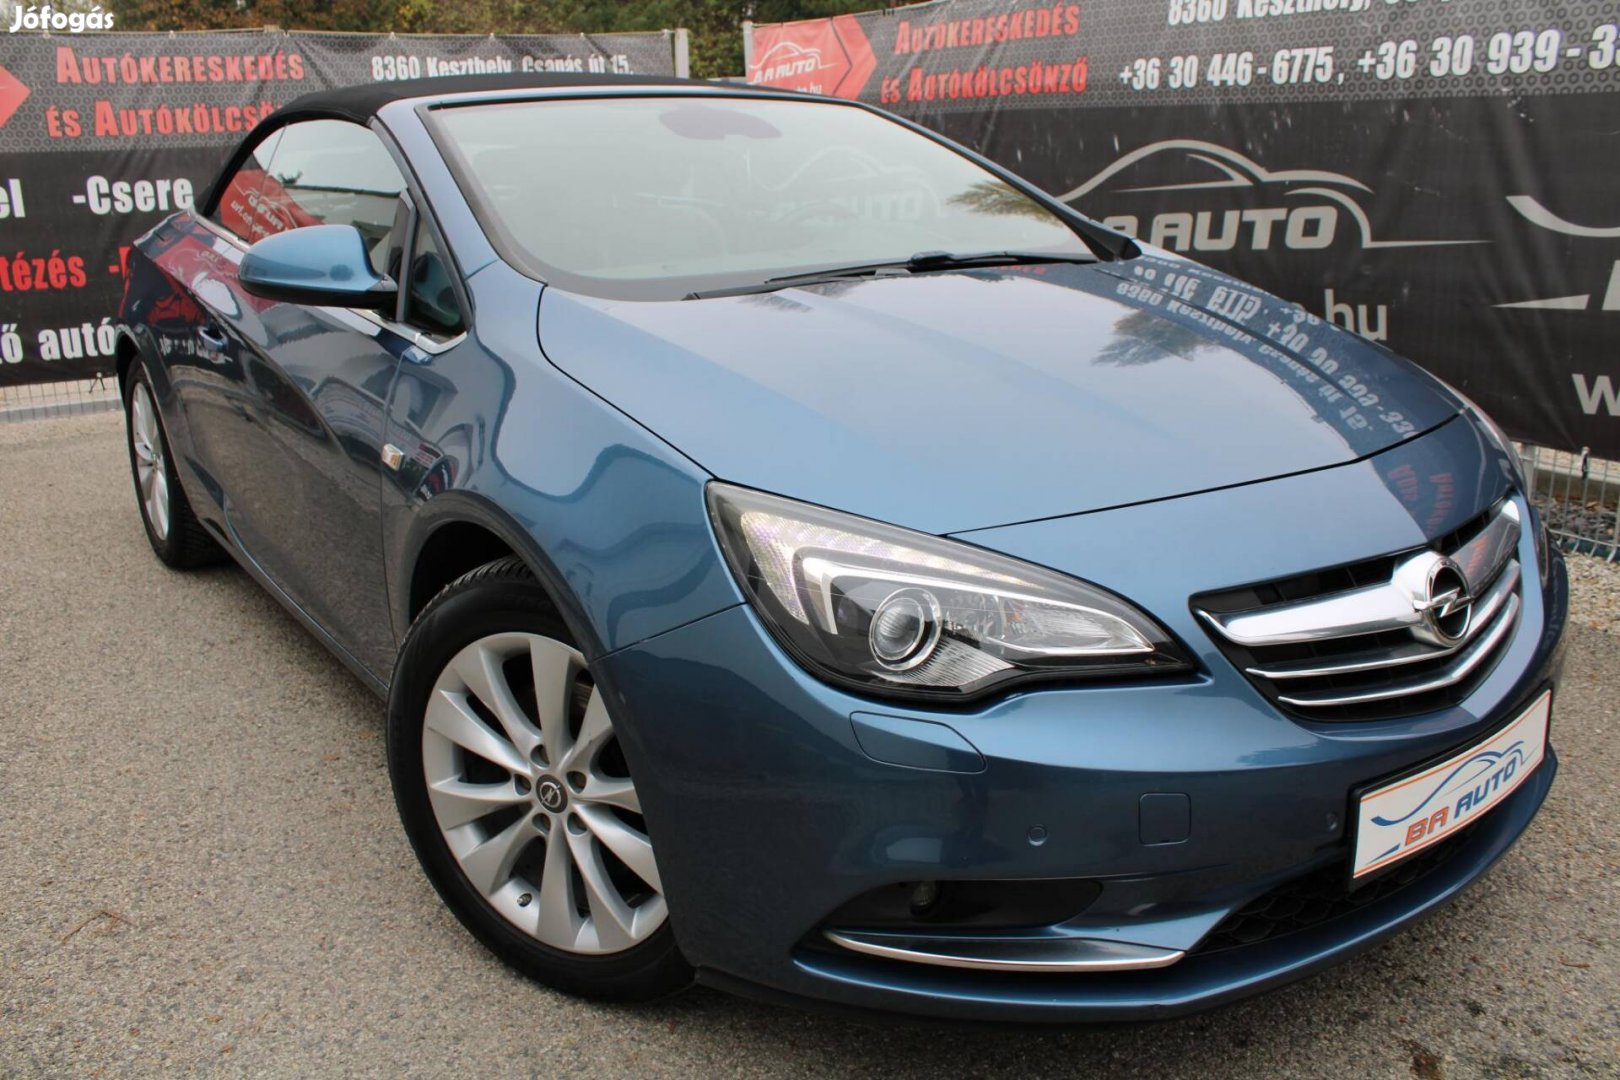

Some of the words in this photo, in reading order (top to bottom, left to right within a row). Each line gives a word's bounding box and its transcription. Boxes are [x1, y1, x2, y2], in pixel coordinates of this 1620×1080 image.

[56, 46, 305, 84] AUTÓKERESKEDÉS
[371, 55, 420, 81] 8360
[1119, 58, 1160, 91] +36
[1168, 55, 1199, 89] 30
[1358, 40, 1418, 80] +36
[1429, 34, 1475, 77] 30
[1486, 24, 1620, 75] 939-3
[1150, 206, 1337, 252] AUTO
[0, 322, 23, 364] ő
[1404, 806, 1450, 847] BA
[1453, 755, 1518, 820] AUTO
